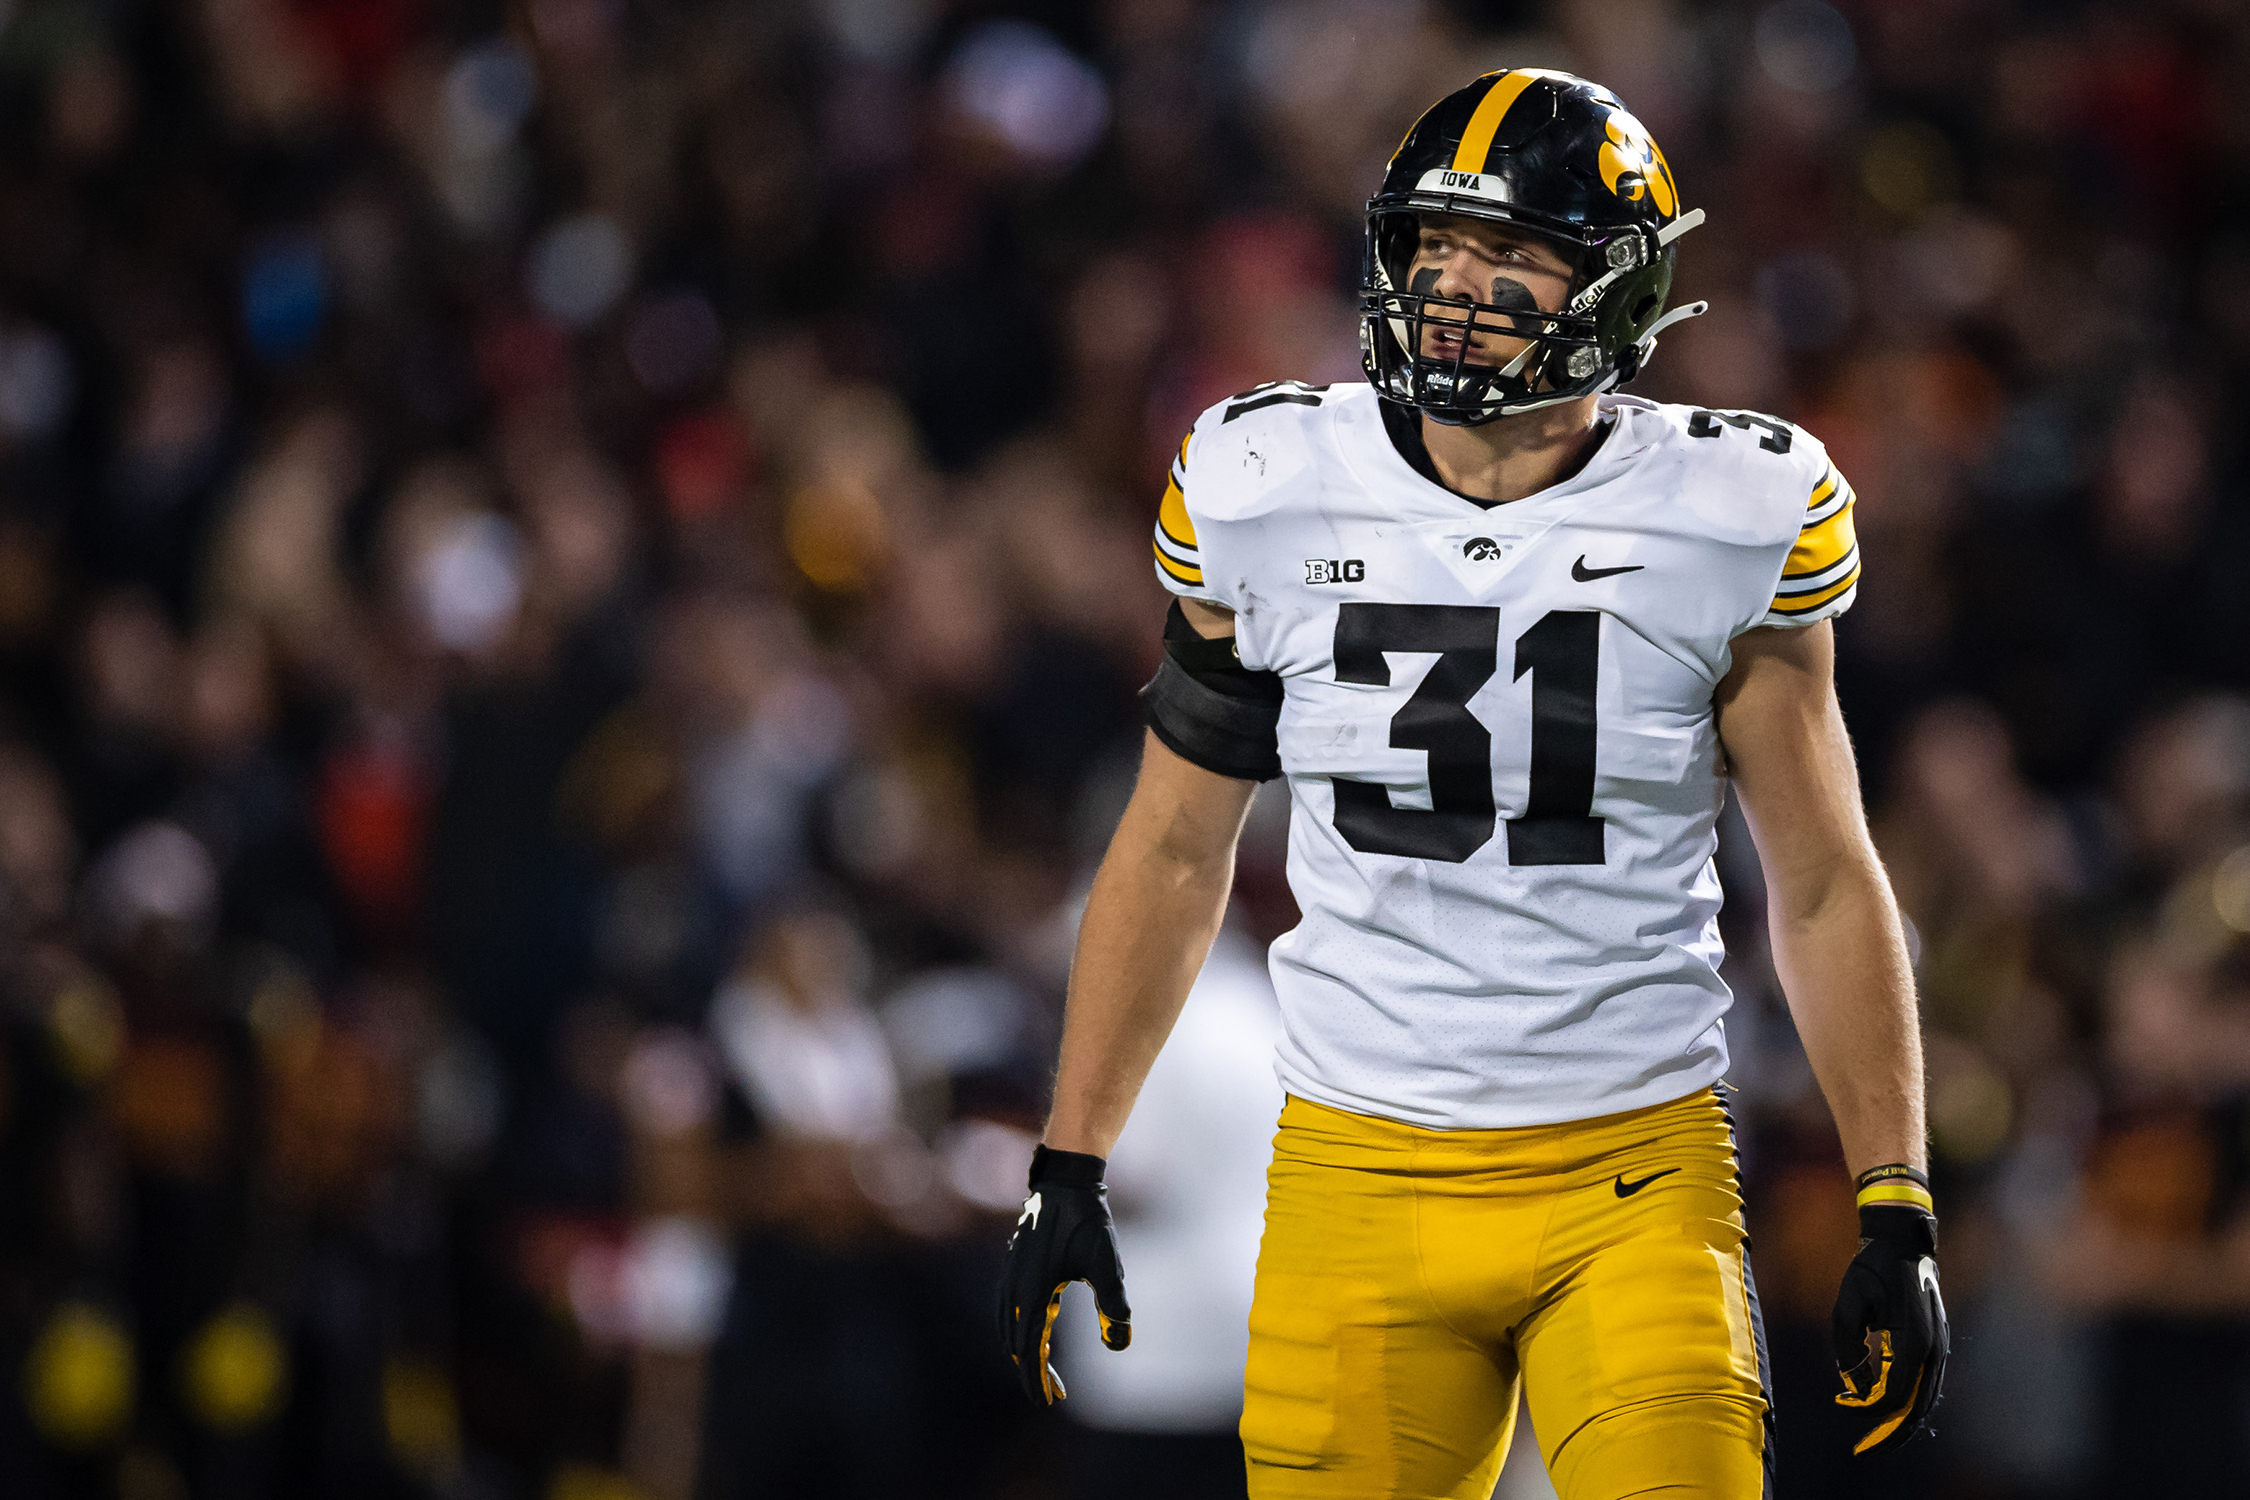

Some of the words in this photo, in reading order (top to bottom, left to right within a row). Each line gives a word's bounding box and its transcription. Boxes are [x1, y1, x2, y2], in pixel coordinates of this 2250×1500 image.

[1440, 171, 1480, 190] IOWA
[1427, 373, 1454, 387] Ridde
[1687, 410, 1793, 455] 3
[1330, 602, 1606, 865] 31
